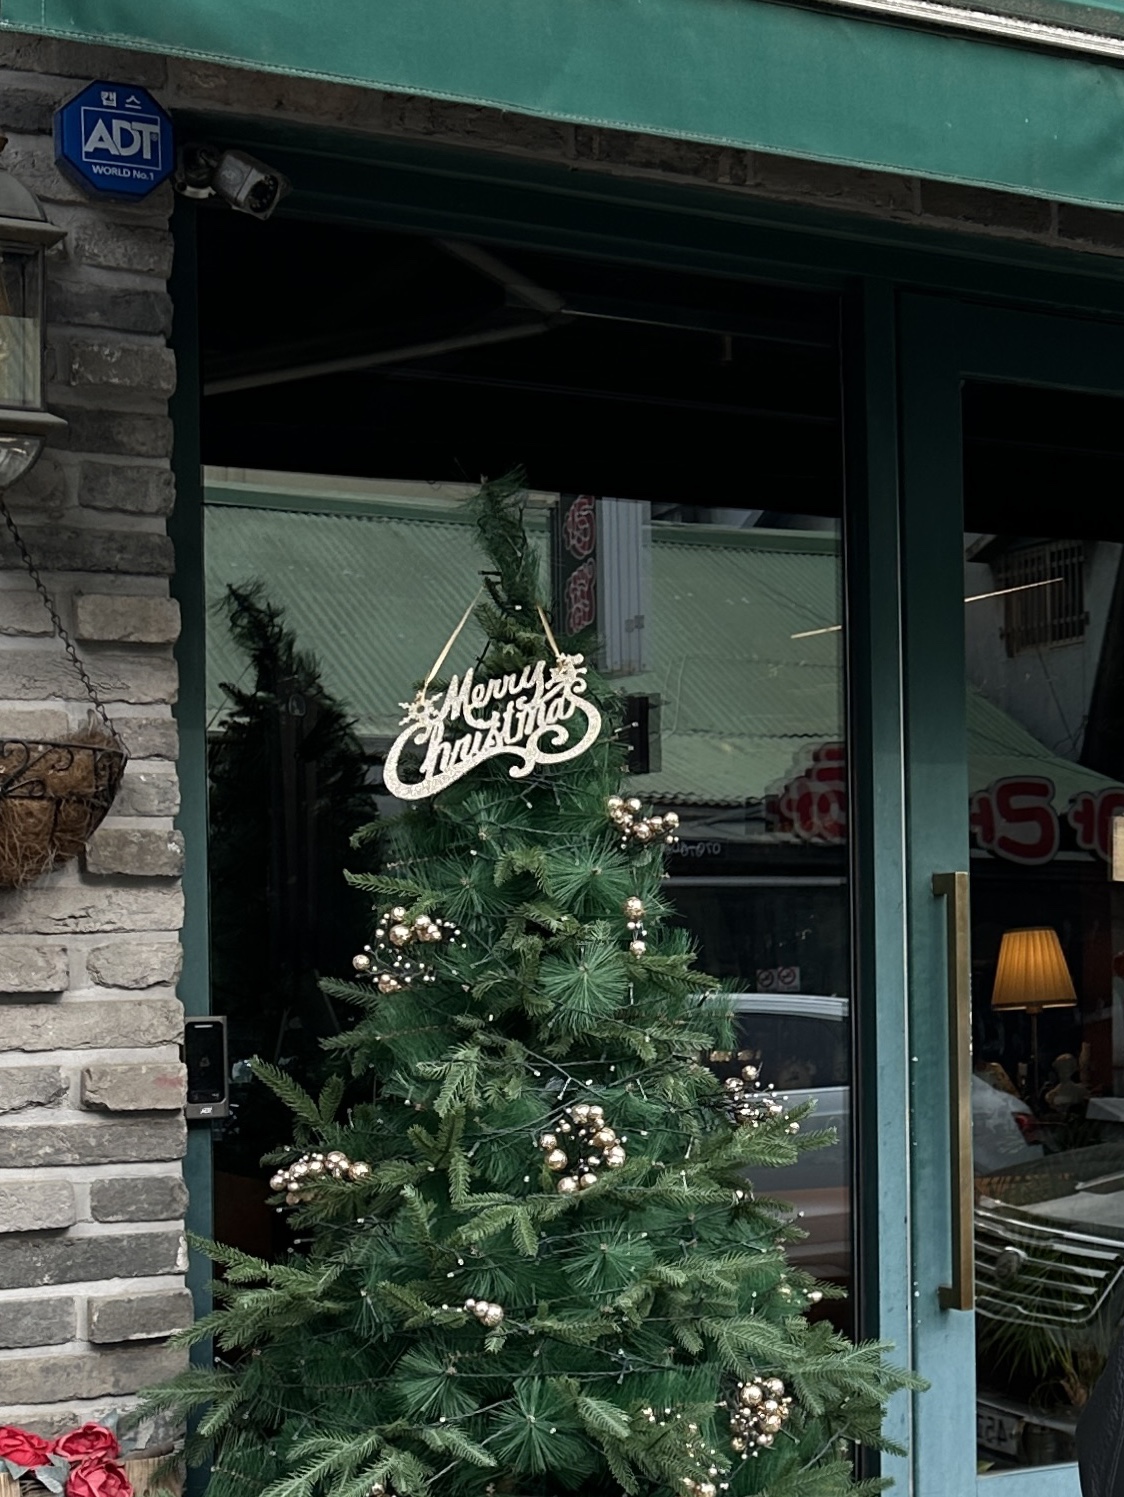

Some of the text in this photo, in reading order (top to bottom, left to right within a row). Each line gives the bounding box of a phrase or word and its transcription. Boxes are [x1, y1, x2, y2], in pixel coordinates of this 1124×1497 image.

[84, 118, 158, 159] ADT
[92, 164, 155, 181] WORLD No.1
[437, 659, 548, 728] Merry
[383, 677, 602, 801] Christmas
